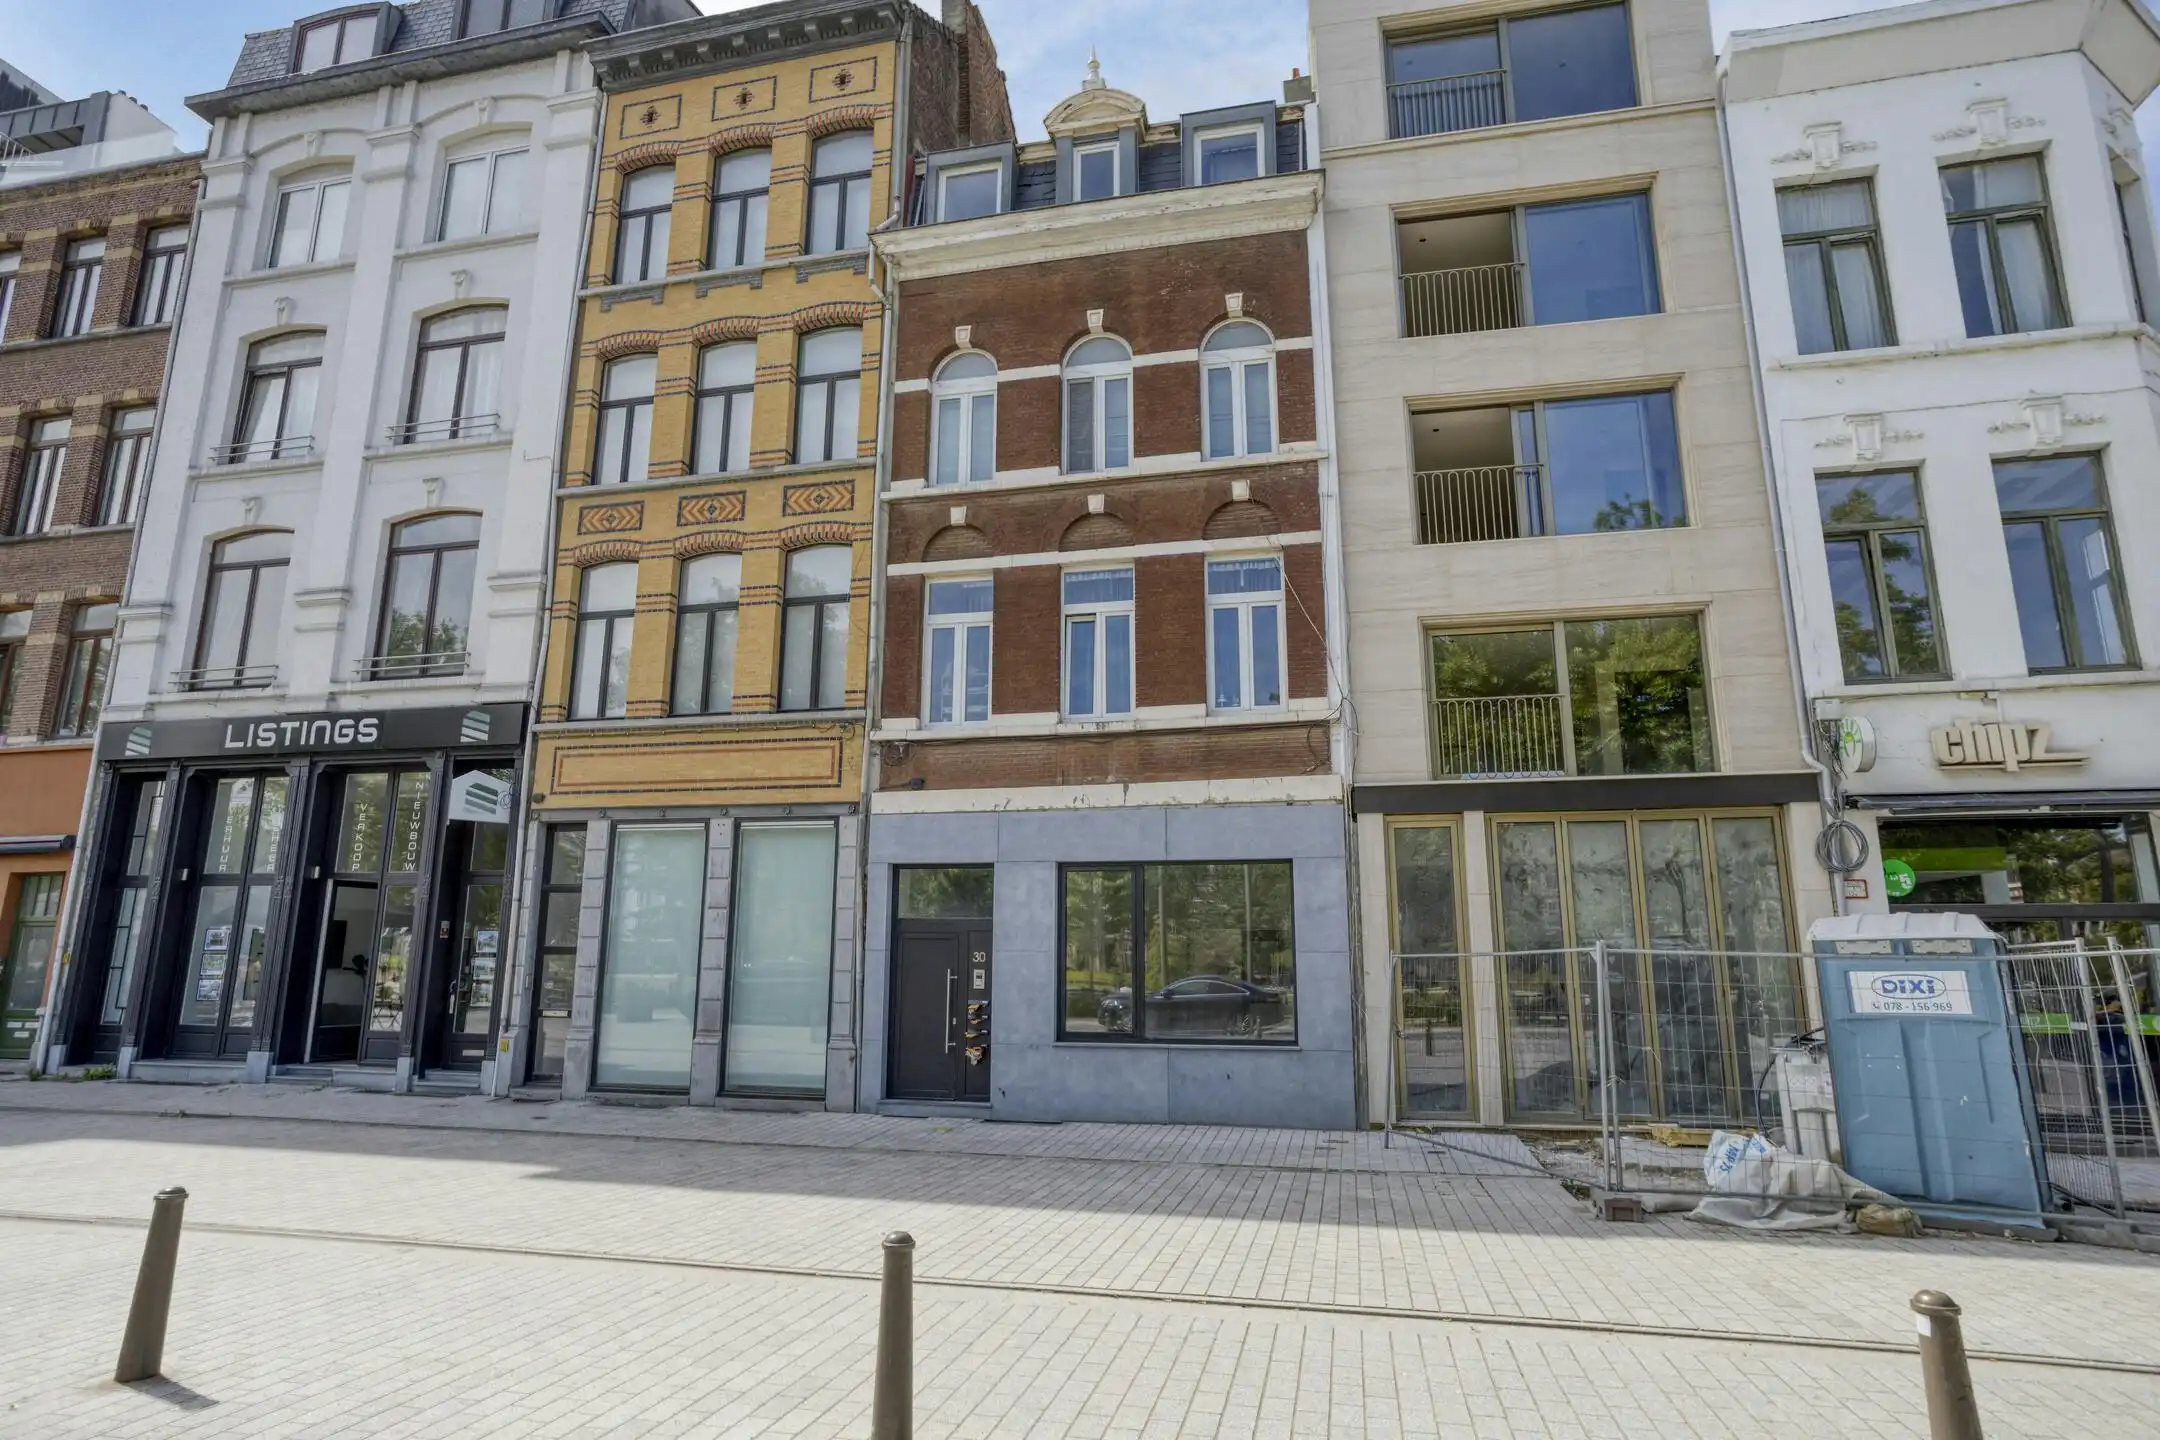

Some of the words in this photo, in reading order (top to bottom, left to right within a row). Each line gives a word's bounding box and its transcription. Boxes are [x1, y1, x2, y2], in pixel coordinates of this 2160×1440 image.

[224, 718, 379, 748] LISTINGS
[218, 806, 235, 873] ERHUUR
[352, 803, 368, 872] VERKOOP
[404, 781, 424, 871] NIEUWBOUW
[973, 951, 986, 962] 30
[1884, 1002, 1903, 1011] 078
[1912, 1002, 1930, 1011] 156
